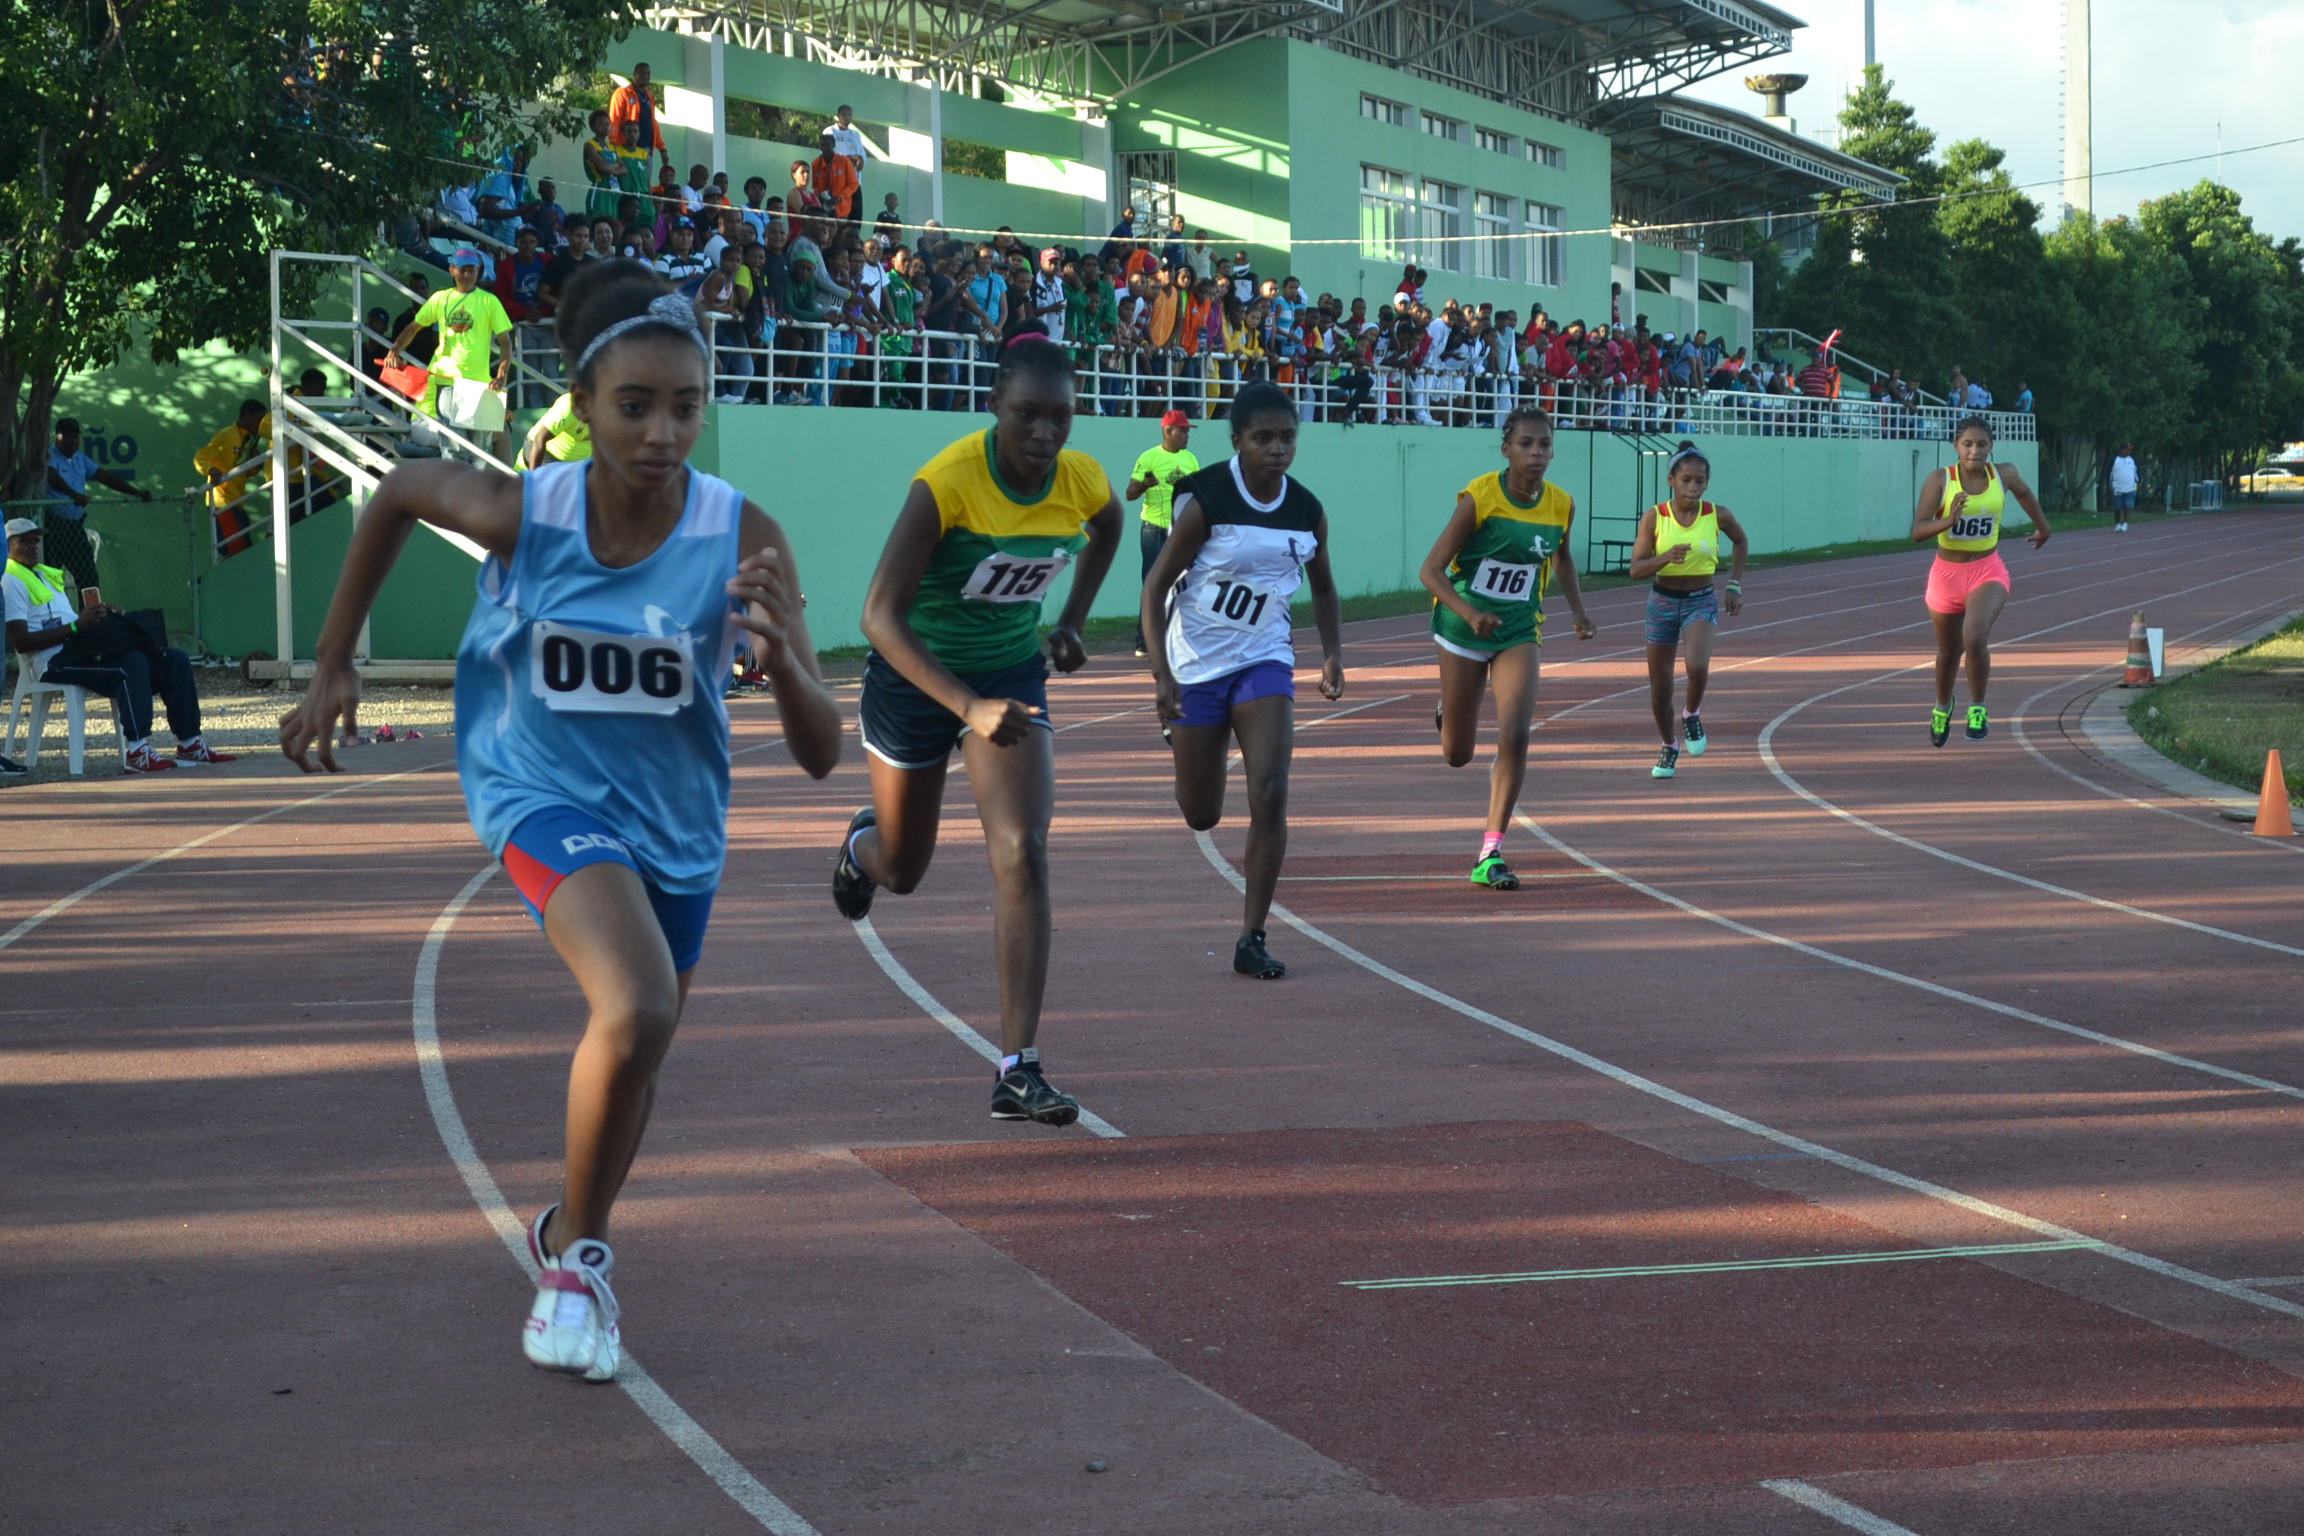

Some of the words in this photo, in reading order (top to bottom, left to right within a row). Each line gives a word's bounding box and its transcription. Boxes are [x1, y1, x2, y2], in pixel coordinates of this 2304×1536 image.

[1952, 517, 1993, 537] 065
[979, 562, 1055, 596] 115
[1485, 566, 1529, 594] 116
[1211, 579, 1269, 627] 101
[542, 634, 683, 699] 006
